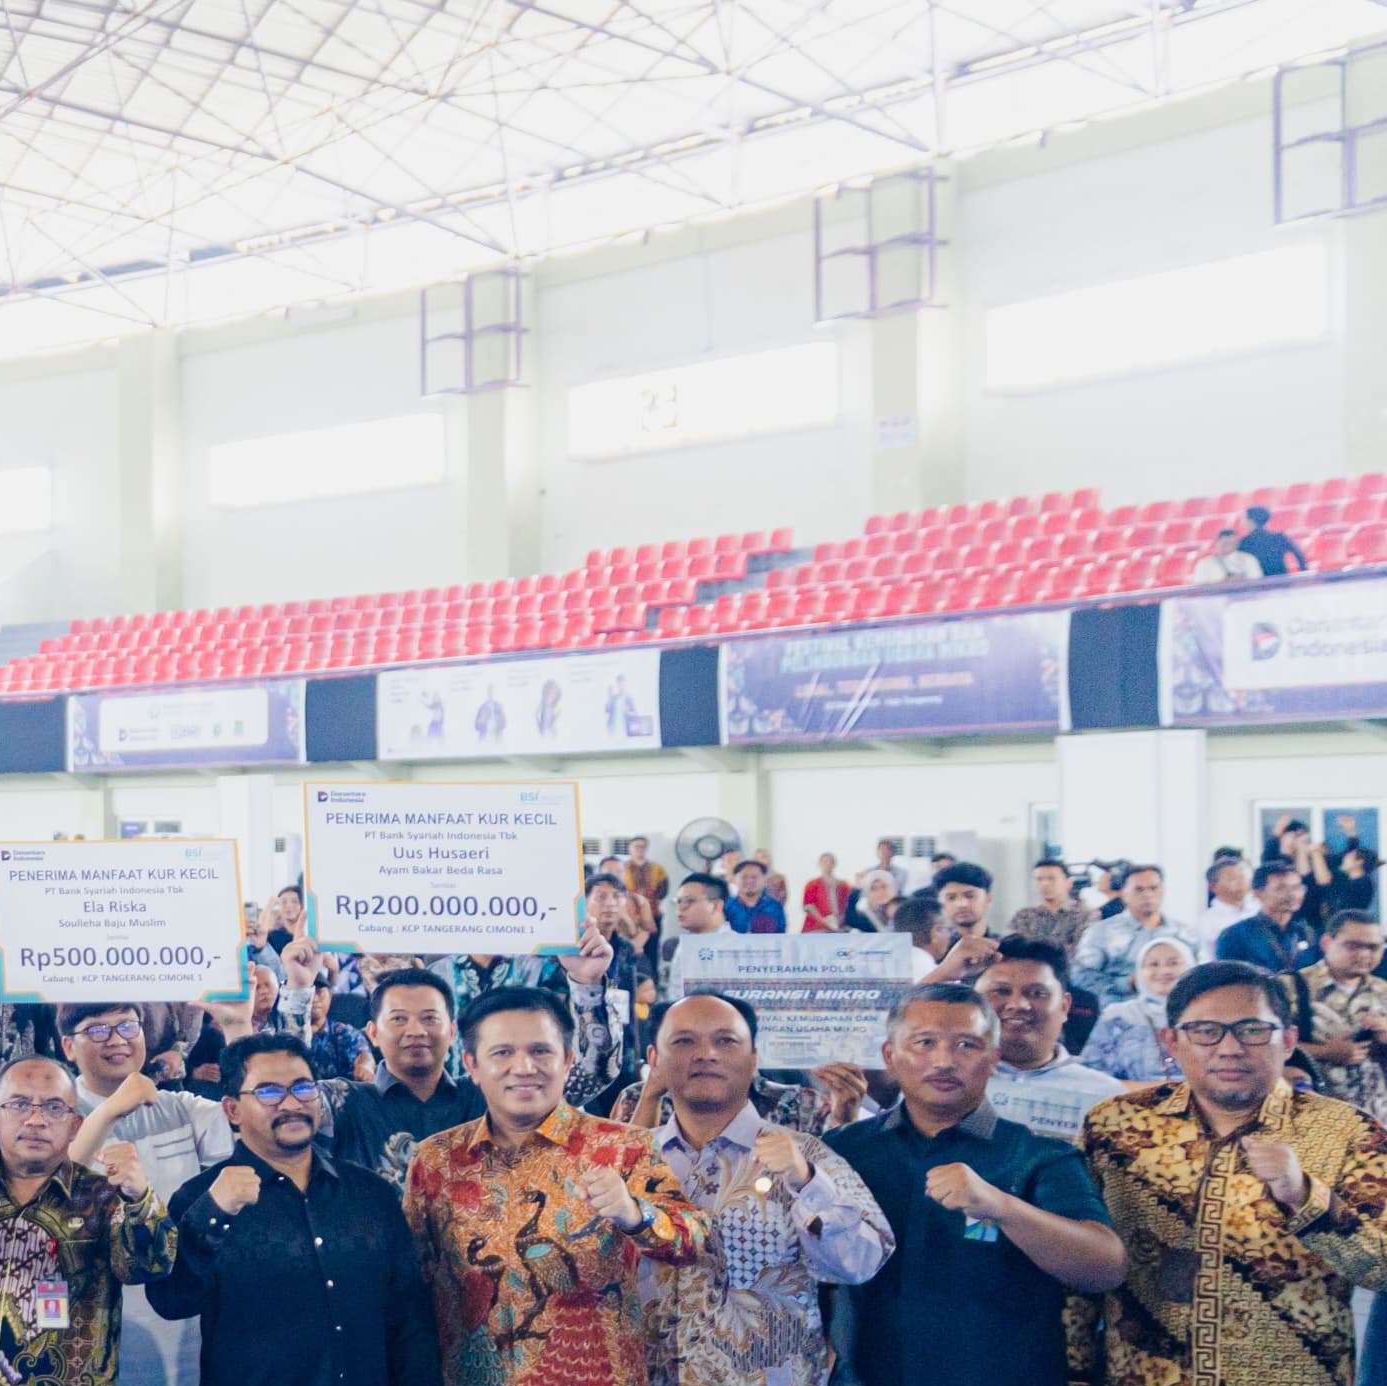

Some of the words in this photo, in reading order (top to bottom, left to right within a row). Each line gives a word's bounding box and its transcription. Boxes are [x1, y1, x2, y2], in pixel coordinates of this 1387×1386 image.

[326, 813, 400, 825] PENERIMA
[405, 813, 474, 825] MANFAAT
[478, 814, 509, 825] KUR
[514, 814, 557, 825] KECIL
[364, 831, 376, 840] PT
[380, 831, 404, 840] Bank
[407, 831, 443, 841] Syariah
[447, 831, 496, 840] Indonesia
[499, 831, 517, 840] Tbk
[393, 847, 424, 859] Uus
[428, 847, 490, 860] Husaeri
[9, 870, 77, 881] PENERIMA
[81, 869, 142, 881] MANFAAT
[148, 869, 176, 880] KUR
[180, 868, 219, 879] KECIL
[379, 866, 409, 877] Ayam
[413, 866, 443, 875] Bakar
[447, 866, 474, 875] Beda
[477, 866, 503, 875] Rasa
[45, 887, 55, 895] PT
[59, 887, 81, 895] Bank
[84, 886, 117, 896] Syariah
[120, 886, 164, 895] Indonesia
[168, 886, 183, 894] Tbk
[83, 902, 104, 913] Ela
[109, 901, 147, 913] Riska
[335, 895, 558, 920] Rp200.000.000,-
[104, 919, 126, 929] Baju
[129, 918, 166, 928] Muslim
[358, 924, 393, 934] Cabang
[402, 924, 420, 934] KCP
[423, 924, 484, 934] TANGERANG
[485, 924, 526, 934] CIMONE
[529, 925, 535, 934] 1
[21, 946, 221, 971] Rp500.000.000,-
[738, 965, 818, 973] PENYERAHAN
[822, 964, 856, 973] POLIS
[43, 974, 75, 983] Cabang
[82, 974, 99, 983] KCP
[101, 974, 156, 983] TANGERANG
[158, 974, 195, 982] CIMONE
[723, 989, 808, 1000] SURANSI
[815, 989, 881, 1000] MIKRO
[1030, 1115, 1078, 1129] PENYER
